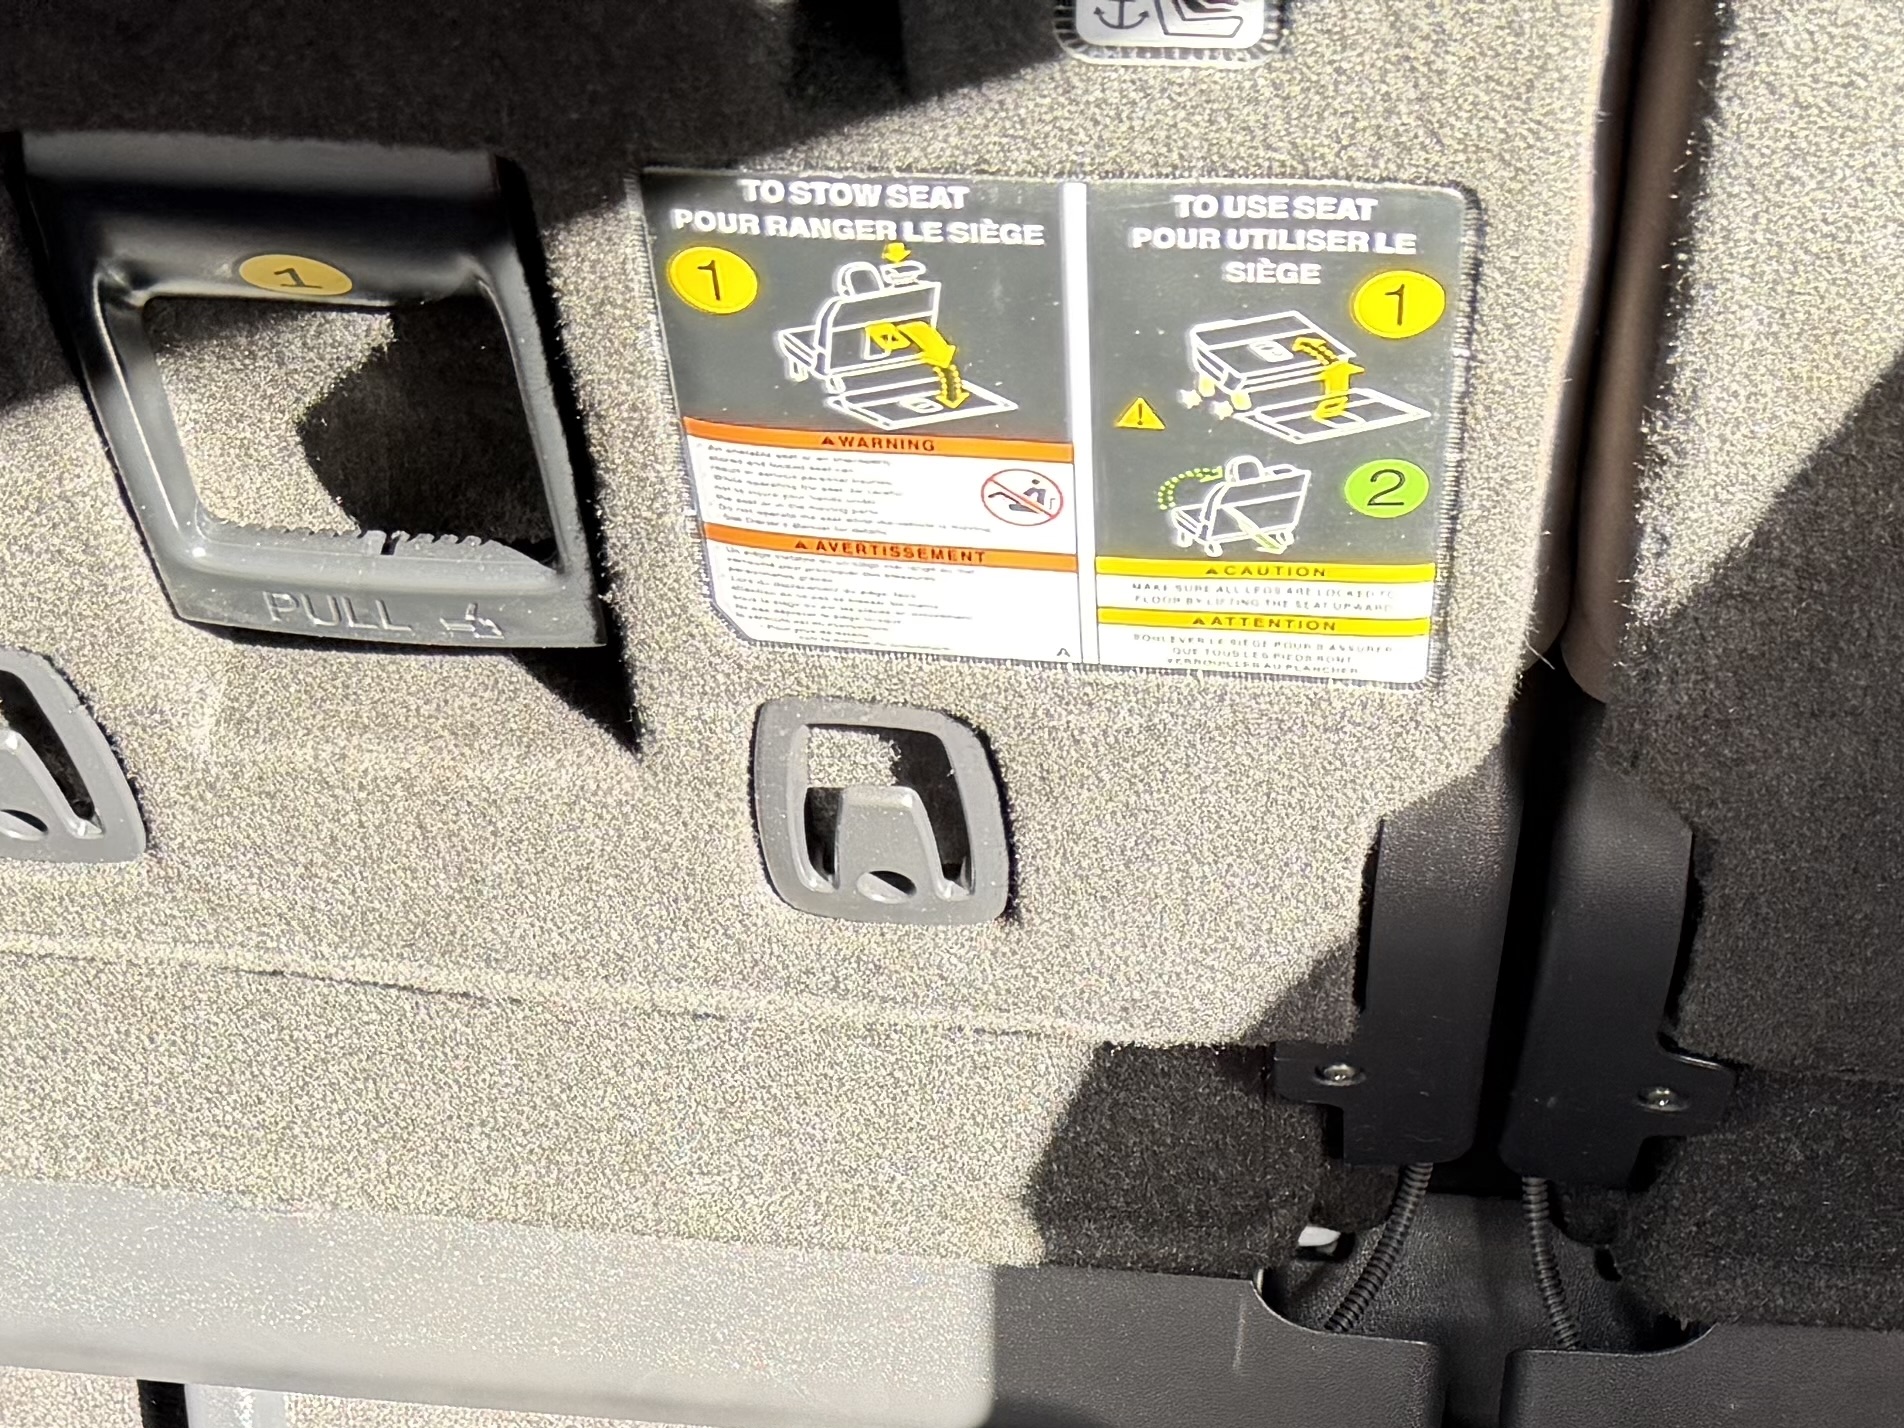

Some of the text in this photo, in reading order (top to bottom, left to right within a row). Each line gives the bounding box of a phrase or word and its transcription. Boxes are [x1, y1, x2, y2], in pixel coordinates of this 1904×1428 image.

[741, 178, 970, 210] TO STOW SEAT
[1174, 194, 1379, 222] TO USE SEAT
[671, 209, 1047, 247] POUR RANGER LE SIÈGE
[1131, 227, 1418, 256] POUR UTILISER LE
[272, 267, 323, 290] 1
[699, 258, 724, 301] 1
[1224, 257, 1323, 286] SIÈGE
[1384, 283, 1407, 327] 1
[837, 434, 936, 453] WARNING
[1366, 468, 1406, 507] 2
[815, 539, 987, 564] AVERTISSEMENT
[1223, 566, 1326, 578] CAUTION
[260, 590, 414, 635] PULL
[1211, 615, 1337, 632] ATTENTION
